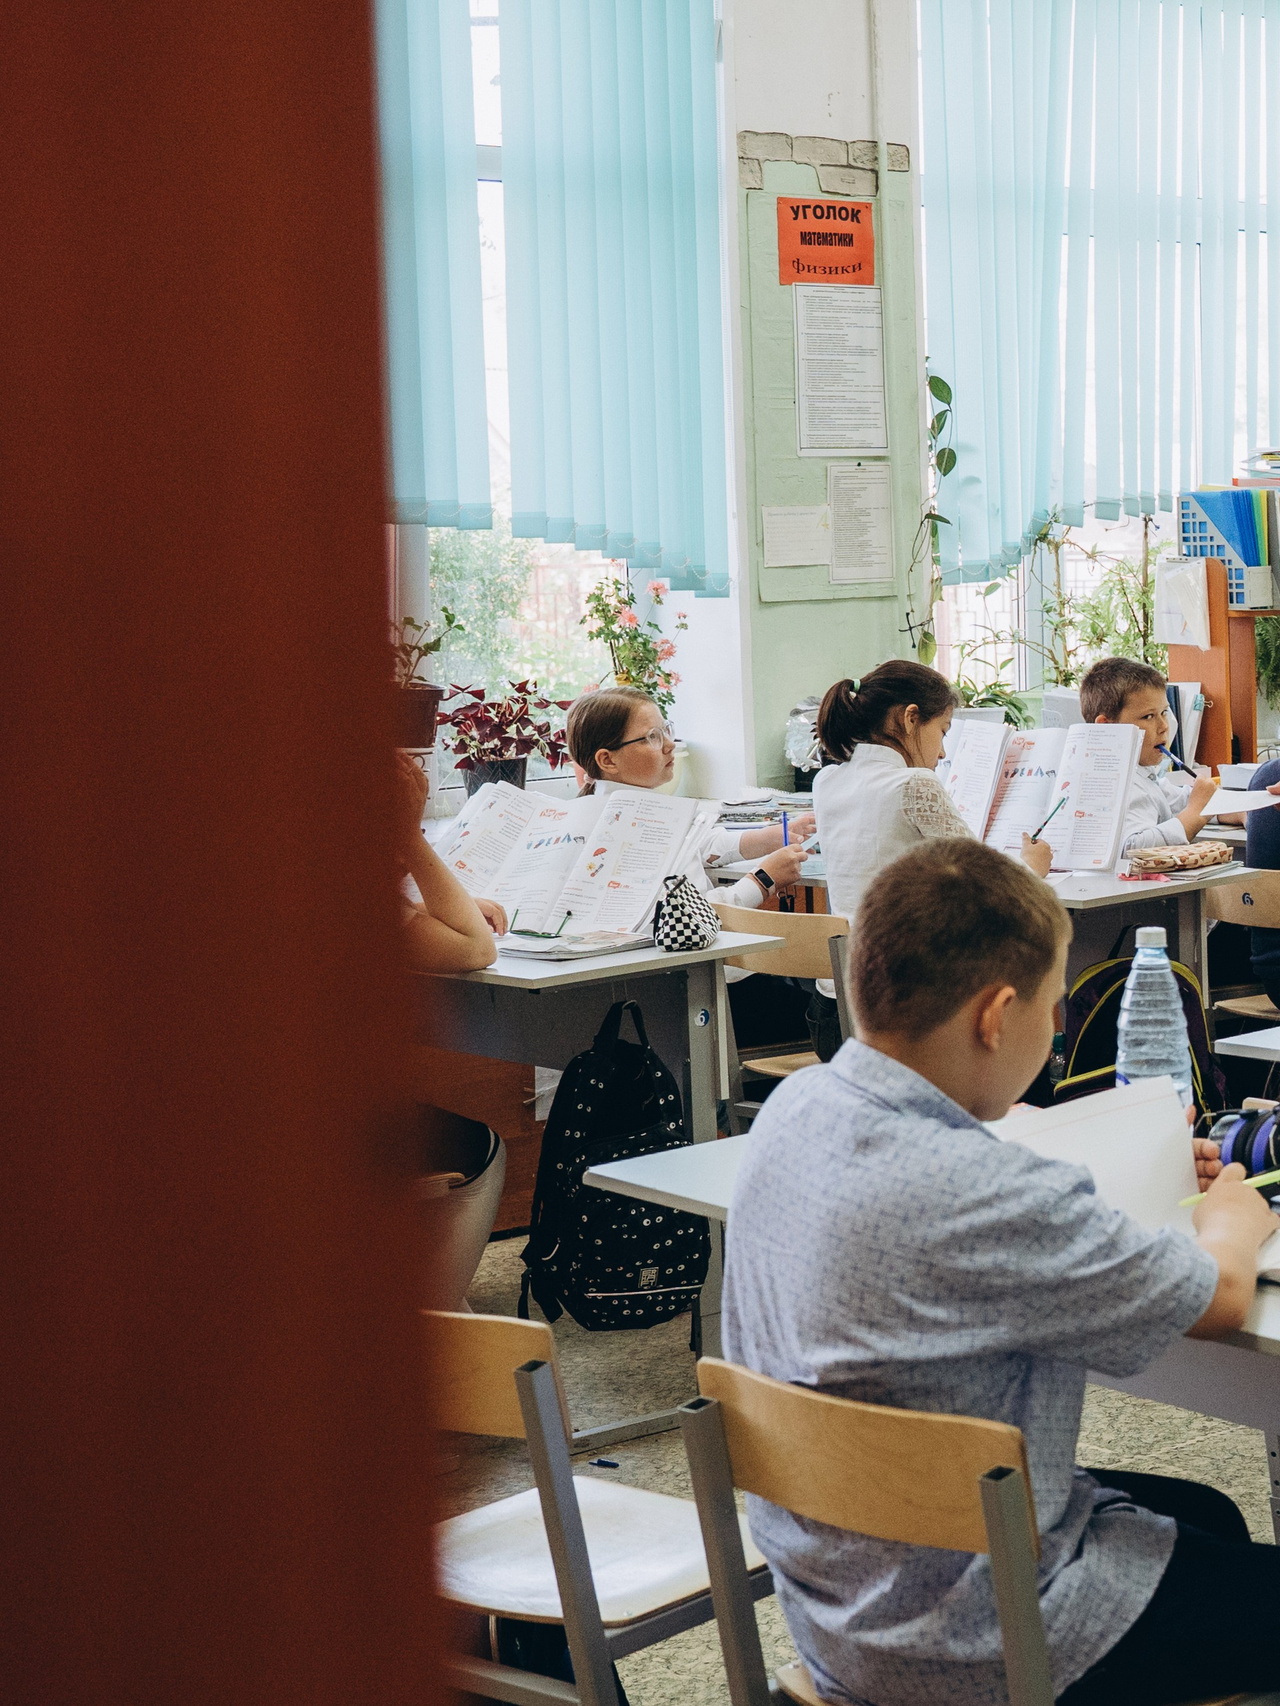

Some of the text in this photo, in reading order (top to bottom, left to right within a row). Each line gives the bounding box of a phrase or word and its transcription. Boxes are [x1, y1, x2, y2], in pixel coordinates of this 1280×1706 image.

[790, 204, 861, 224] УГОЛОК
[800, 231, 854, 248] математики
[792, 257, 863, 275] физики
